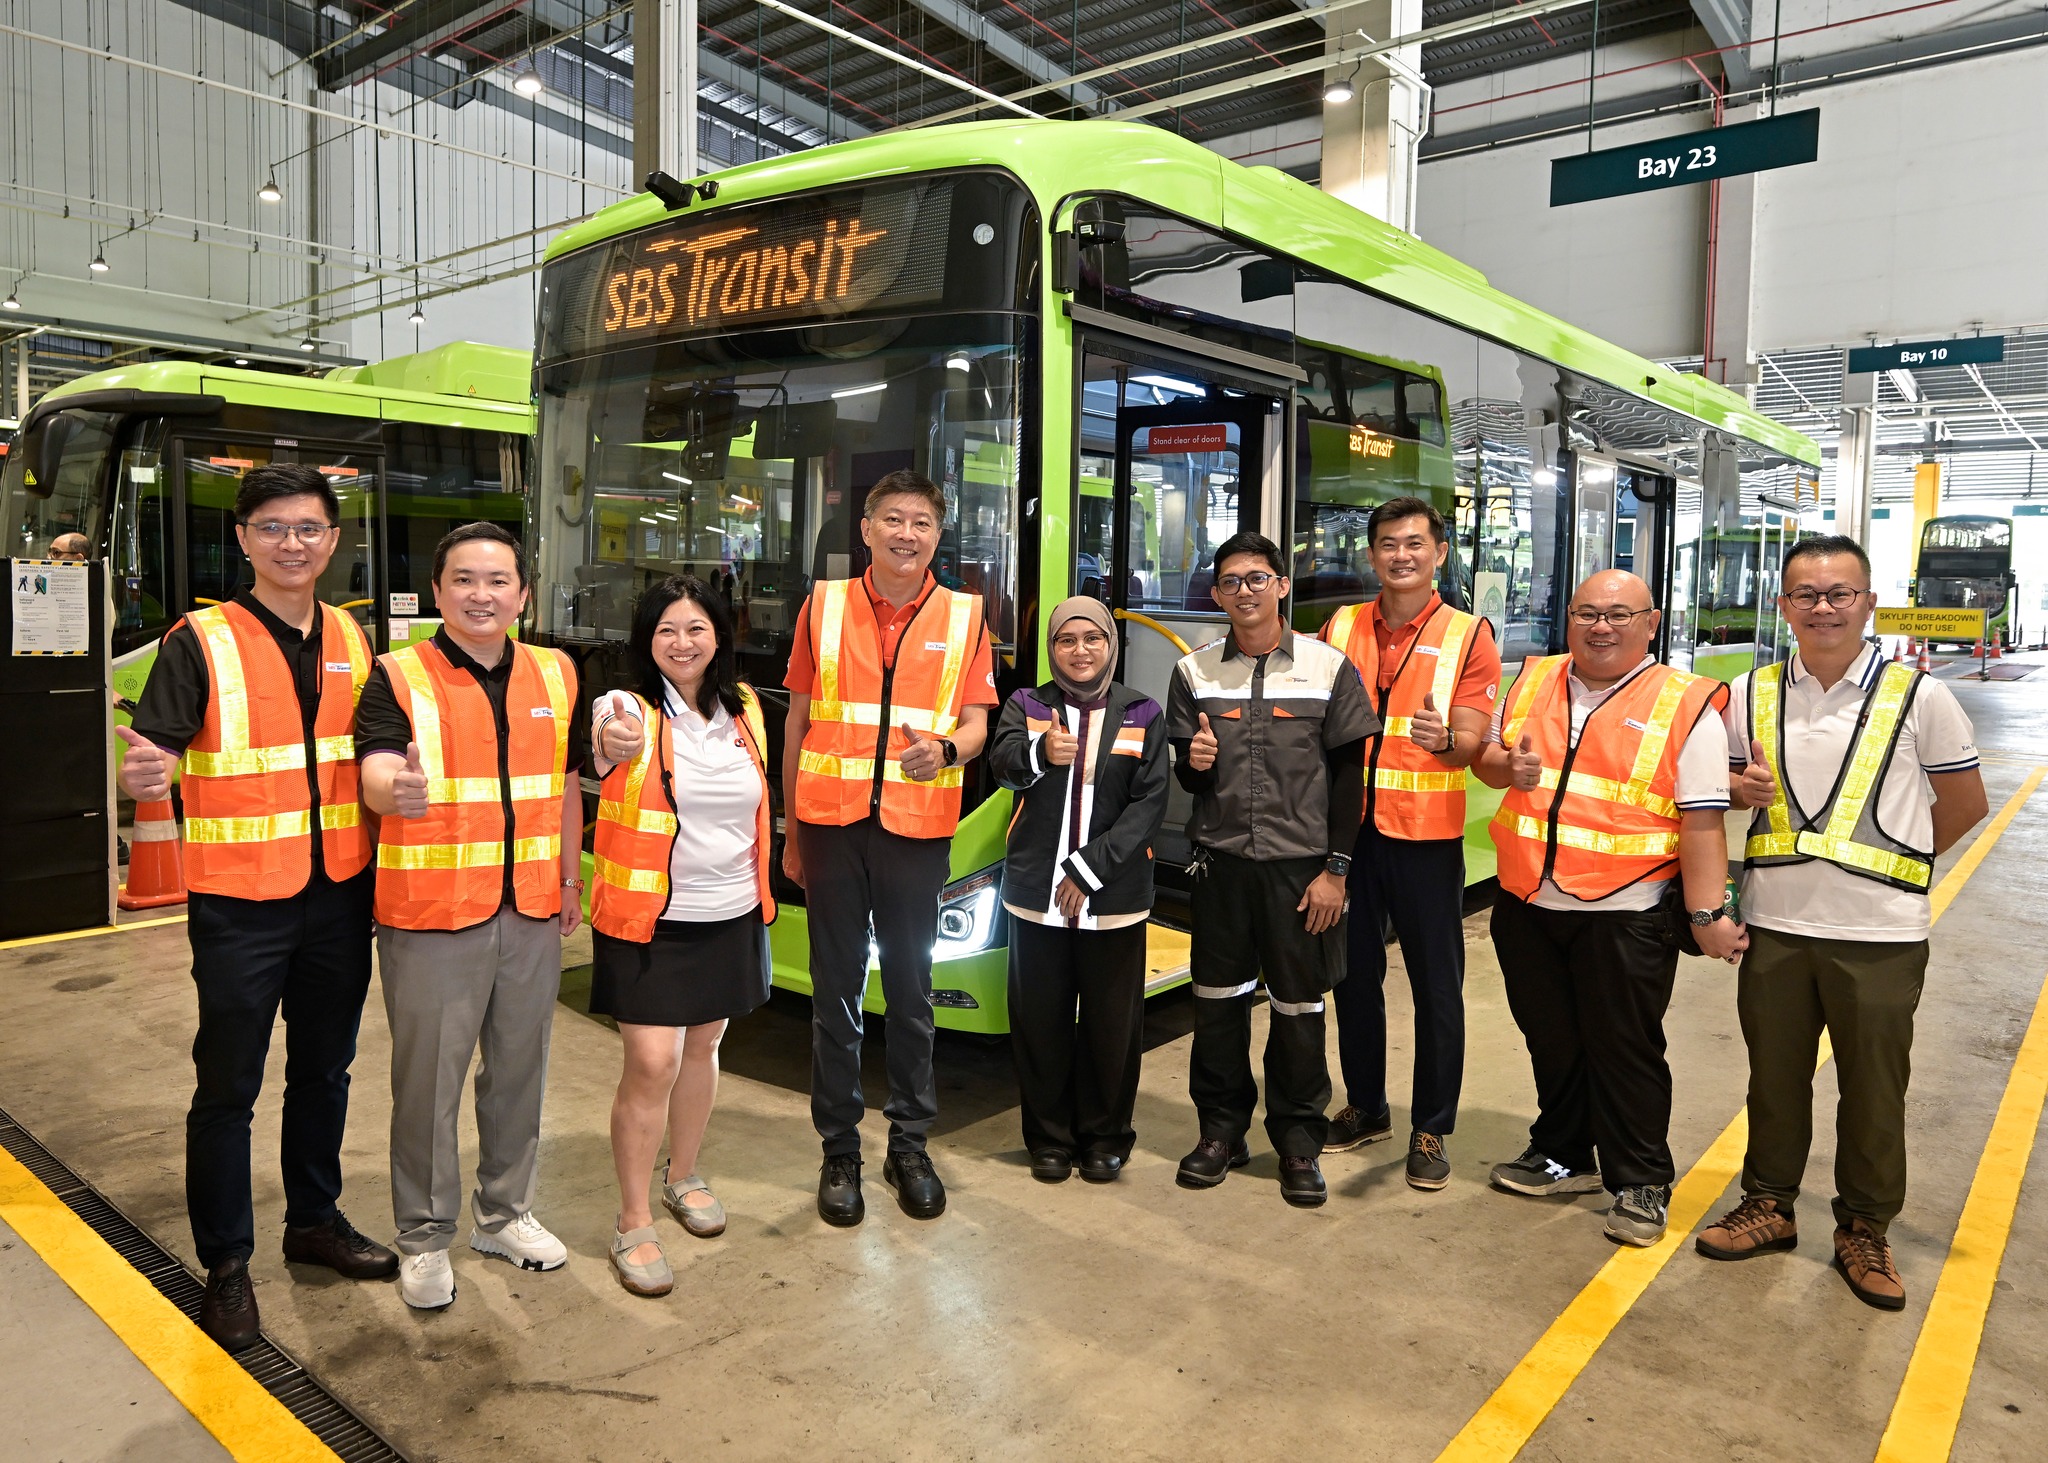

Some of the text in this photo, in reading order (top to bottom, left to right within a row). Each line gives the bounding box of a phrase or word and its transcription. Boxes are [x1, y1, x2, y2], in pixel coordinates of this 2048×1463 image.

[1638, 145, 1717, 179] Bay 23
[604, 219, 888, 332] SBS Transit
[1900, 348, 1948, 364] Bay 10
[1153, 435, 1221, 445] Stand clear of doors
[1360, 429, 1395, 458] Transit
[1879, 612, 1979, 622] SKYLIFT BREAKDOWN!
[1899, 623, 1956, 632] DO NOT USE!
